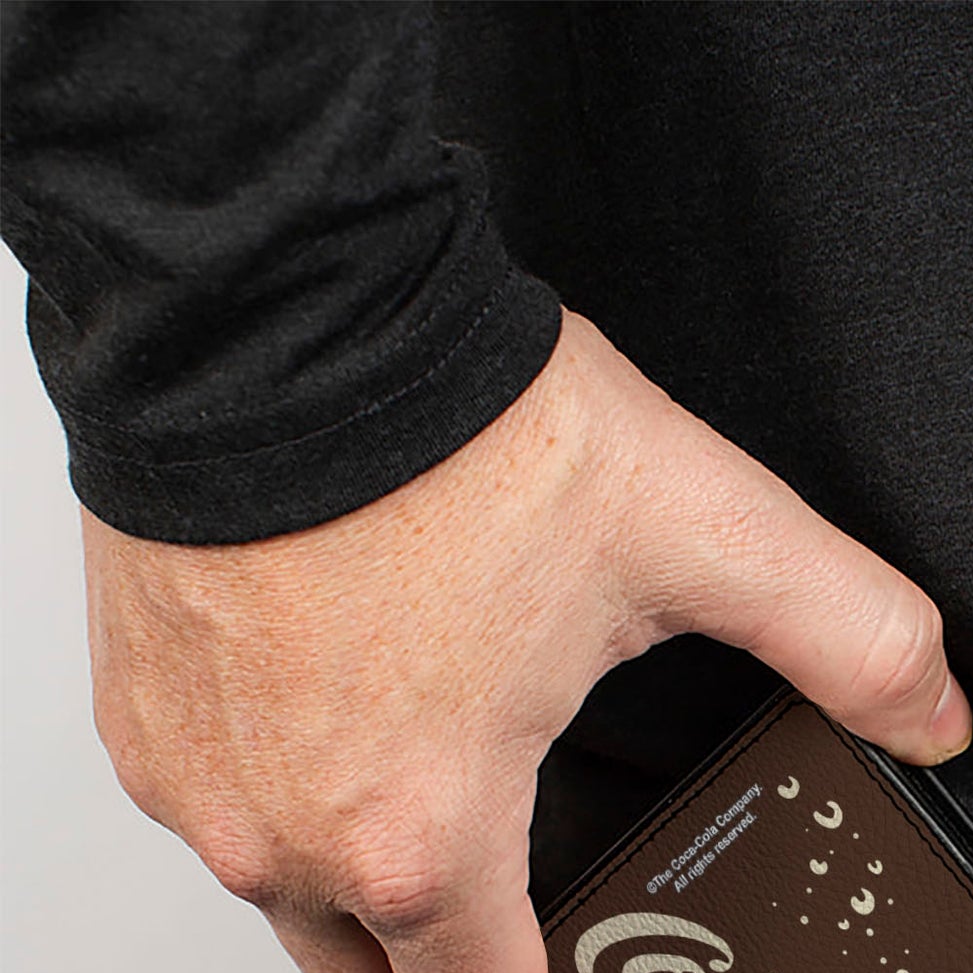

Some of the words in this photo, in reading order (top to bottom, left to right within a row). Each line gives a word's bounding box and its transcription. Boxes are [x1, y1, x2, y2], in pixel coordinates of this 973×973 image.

[671, 825, 718, 871] Coca-Cola
[715, 783, 763, 827] Company.
[673, 874, 689, 893] All
[687, 851, 716, 880] rights
[714, 811, 758, 854] reserved.
